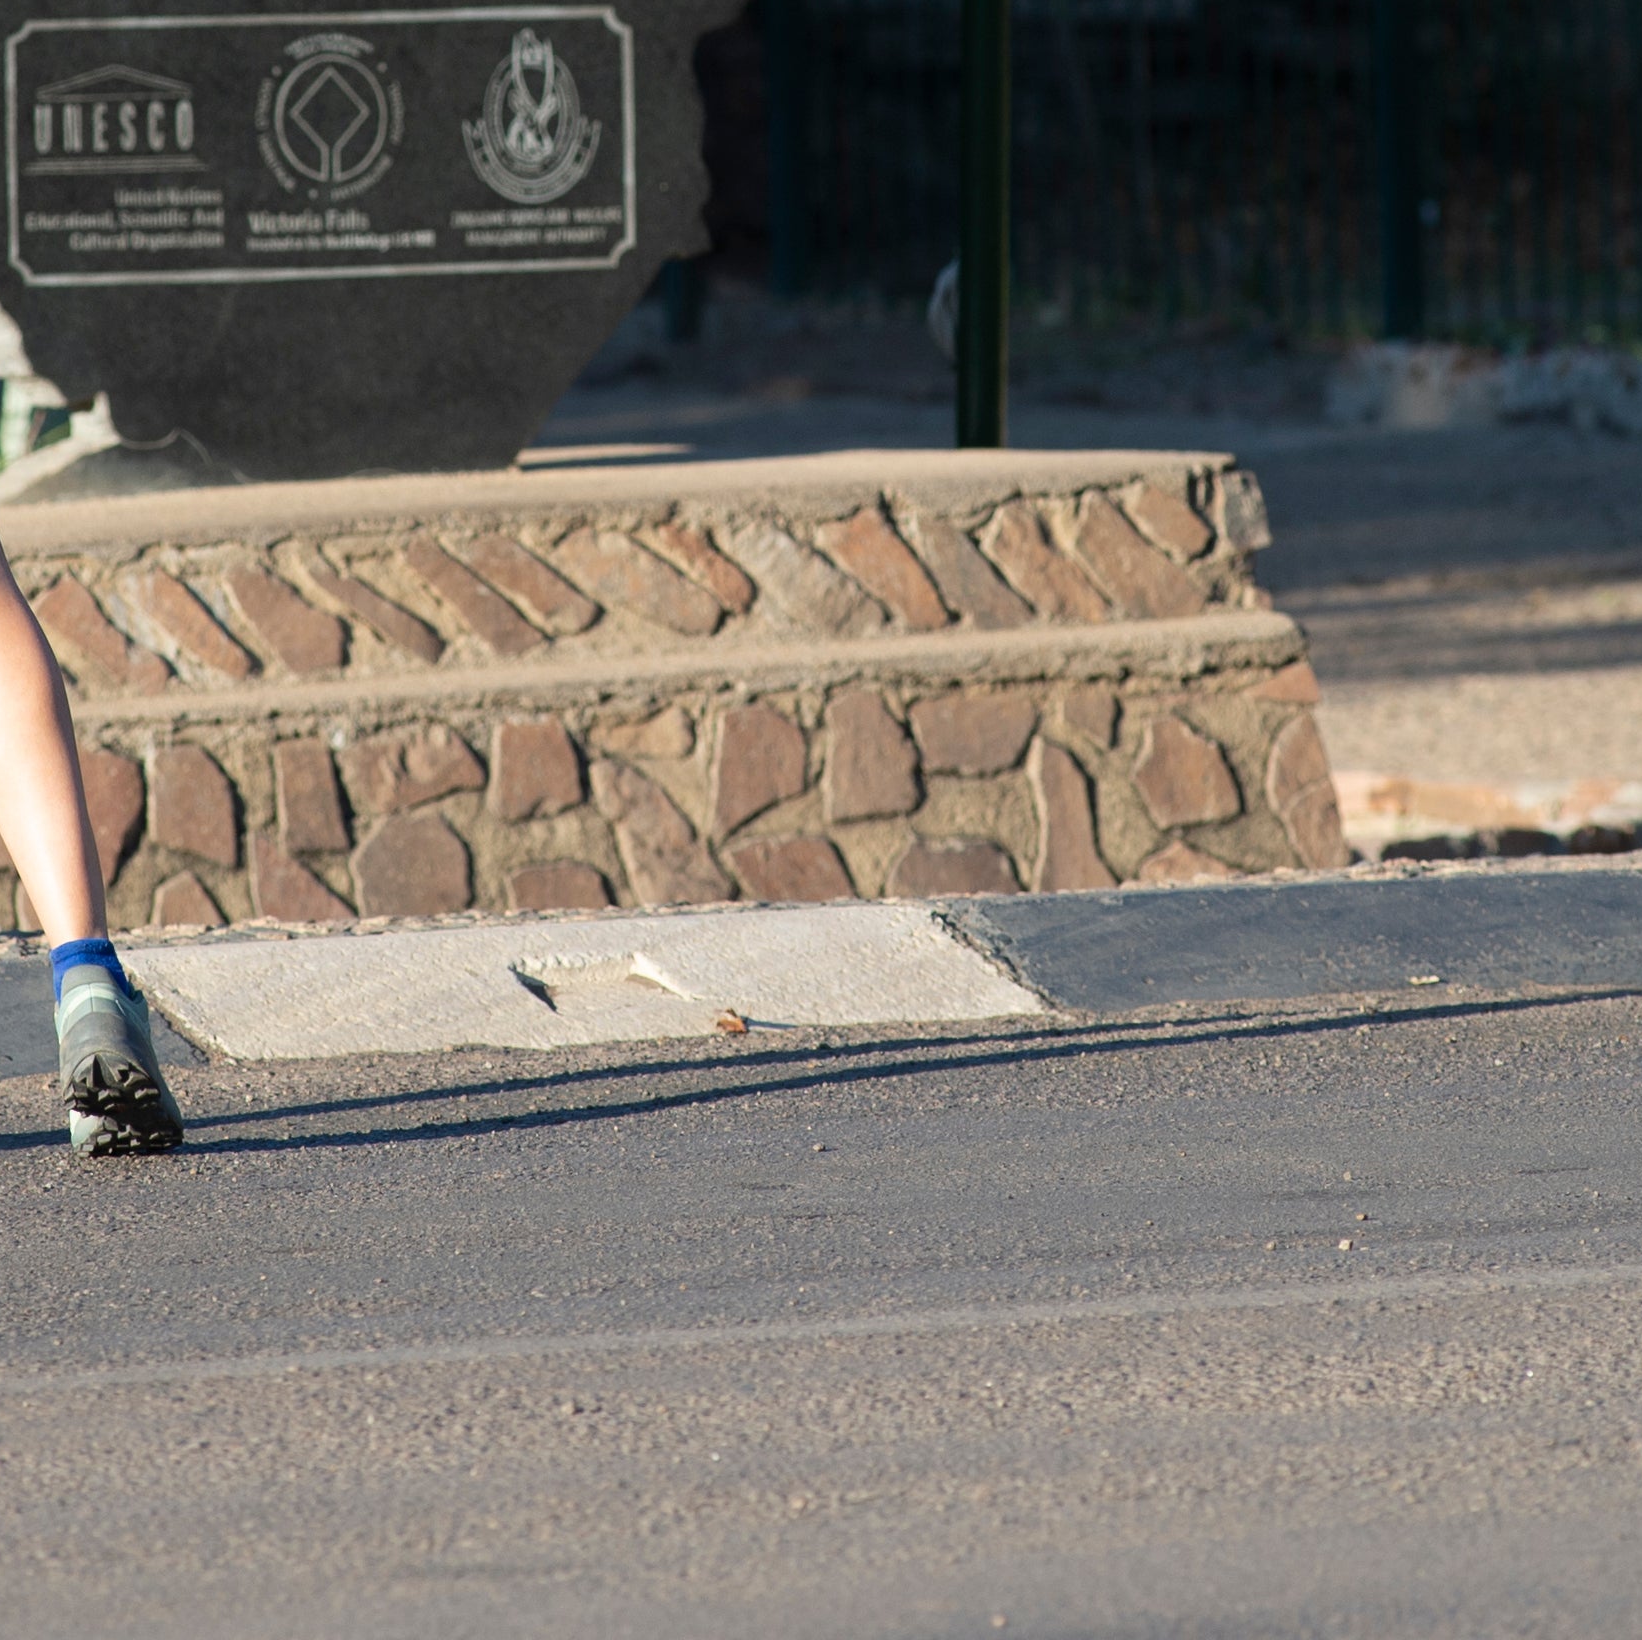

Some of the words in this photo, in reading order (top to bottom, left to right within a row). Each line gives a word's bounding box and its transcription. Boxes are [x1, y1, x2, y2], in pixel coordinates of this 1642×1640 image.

[33, 98, 194, 155] UNESCO
[247, 209, 324, 234] Victoria
[325, 209, 371, 232] Falls
